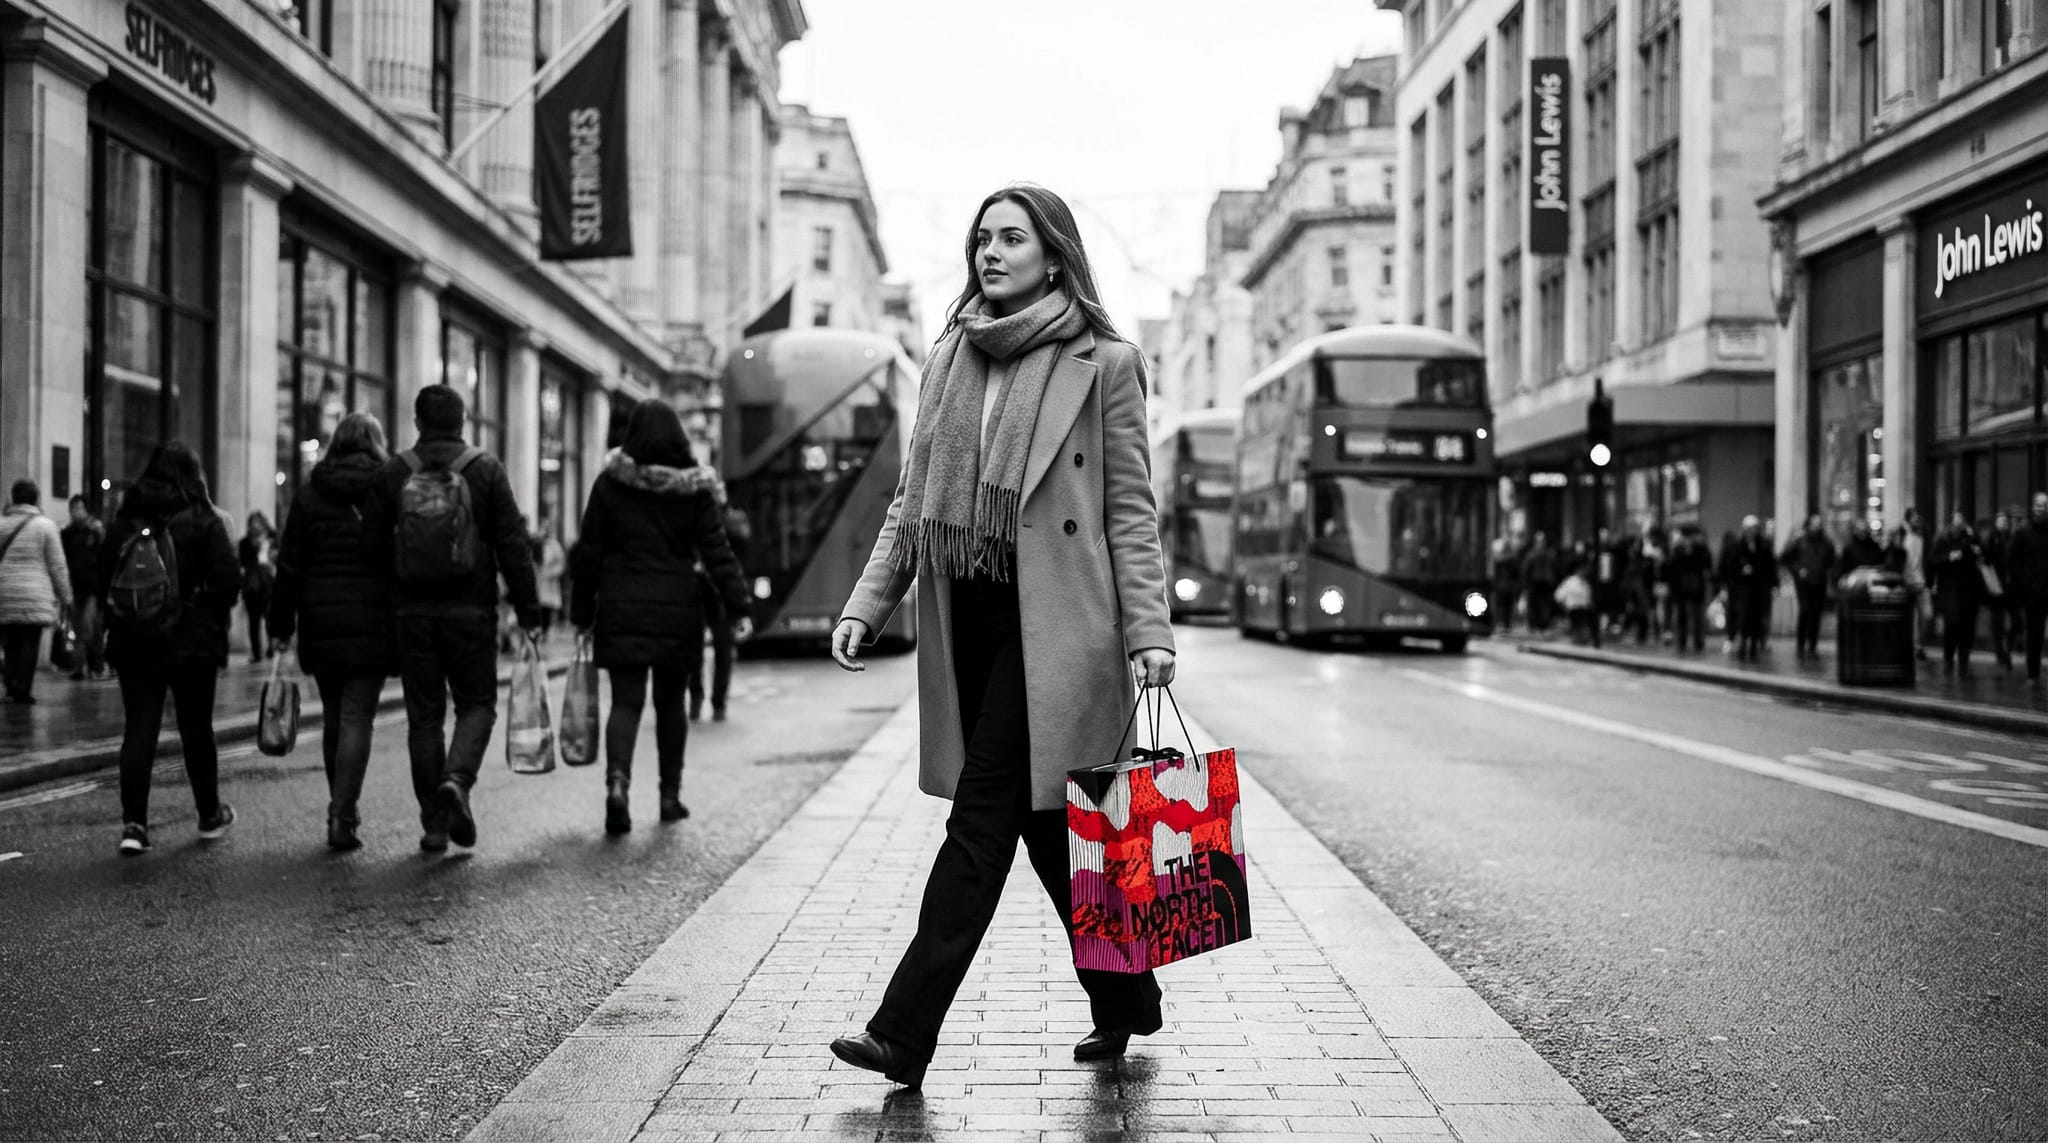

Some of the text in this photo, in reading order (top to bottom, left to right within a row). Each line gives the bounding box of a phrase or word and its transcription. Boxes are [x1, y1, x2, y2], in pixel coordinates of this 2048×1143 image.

[125, 2, 217, 106] SELFRIDGES
[1533, 72, 1568, 212] John Lewis
[1934, 198, 2043, 299] John Lewis
[1131, 883, 1214, 935] NORTH
[1164, 851, 1210, 894] THE
[1158, 918, 1217, 967] FACE
